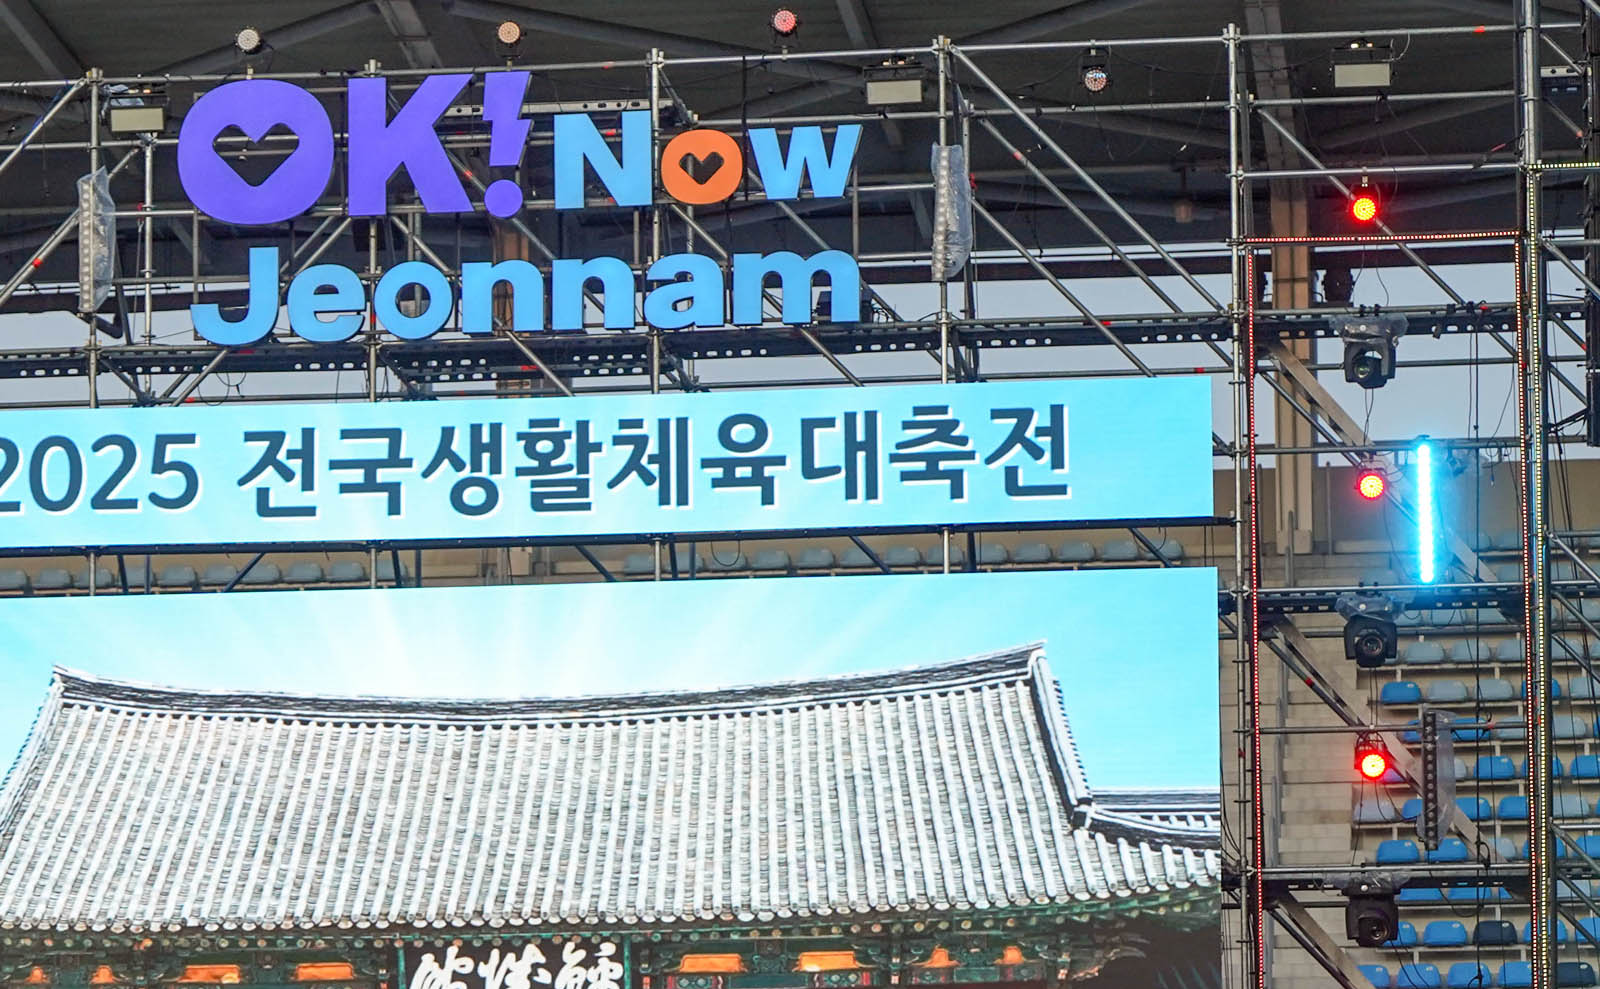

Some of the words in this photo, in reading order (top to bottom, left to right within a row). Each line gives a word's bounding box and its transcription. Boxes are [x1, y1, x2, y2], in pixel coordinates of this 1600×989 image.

[177, 71, 533, 226] OK!
[554, 109, 864, 210] Now
[190, 246, 862, 346] Jeonnam
[236, 403, 1071, 519] 전국생활체육대축전
